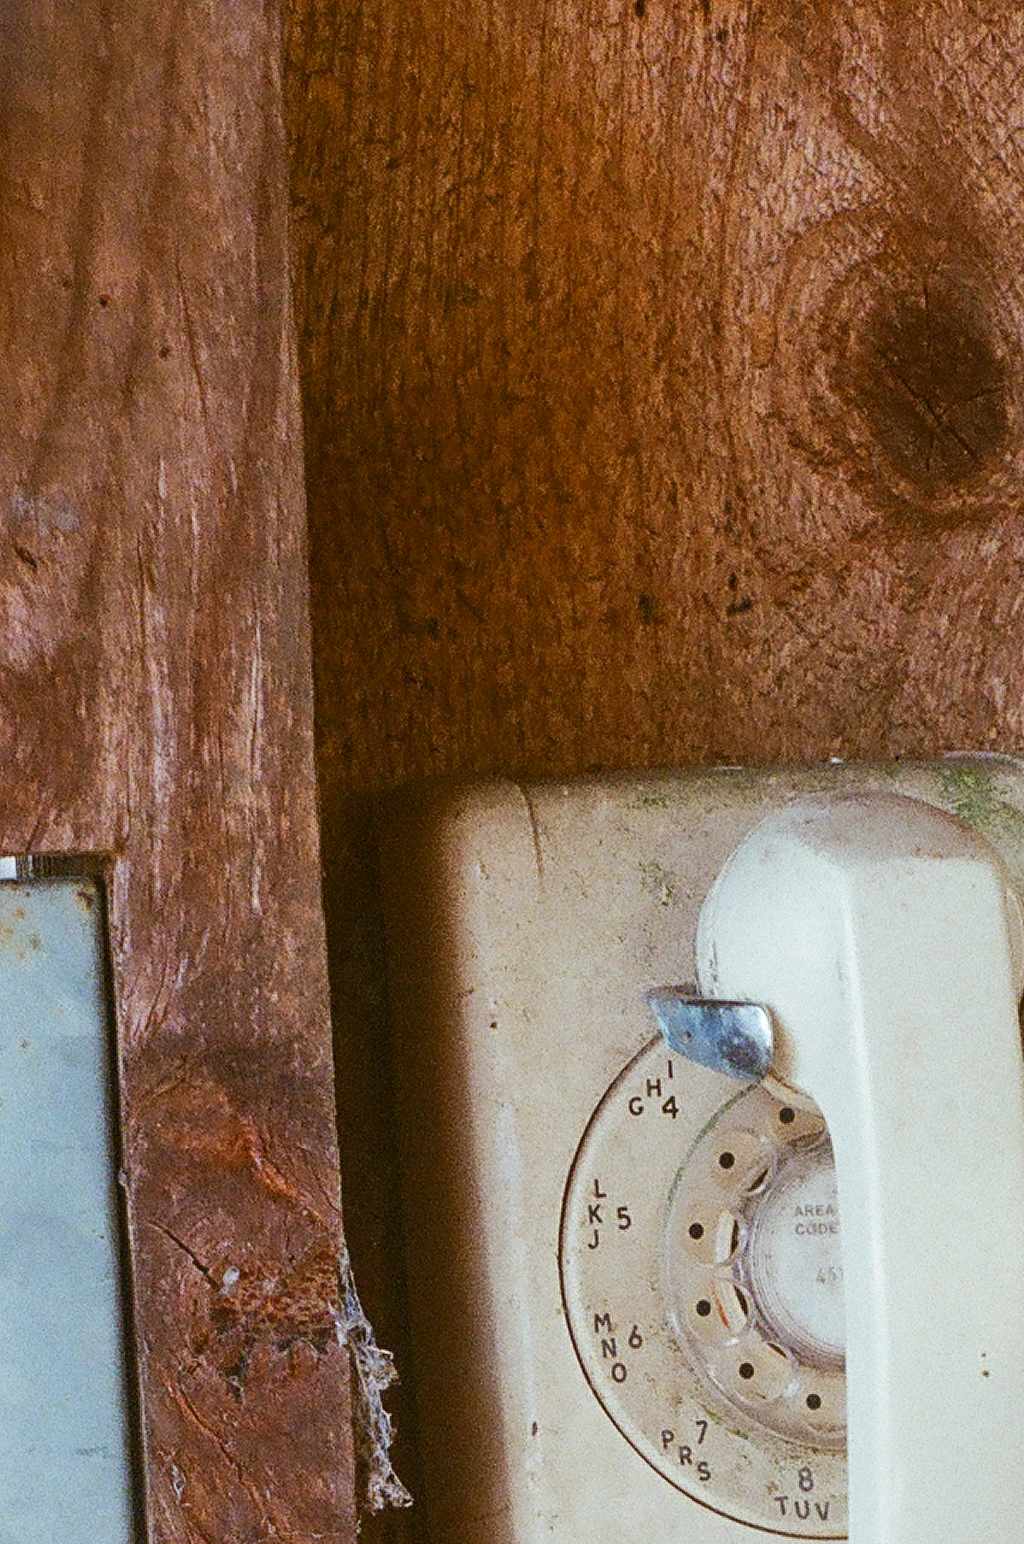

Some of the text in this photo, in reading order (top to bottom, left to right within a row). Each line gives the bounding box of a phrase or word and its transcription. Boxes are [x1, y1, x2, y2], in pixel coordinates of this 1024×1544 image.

[616, 1206, 632, 1230] 5
[793, 1204, 835, 1218] AREA
[794, 1221, 838, 1236] CODE
[628, 1326, 642, 1348] 6
[695, 1419, 708, 1445] 7
[799, 1467, 814, 1493] 8
